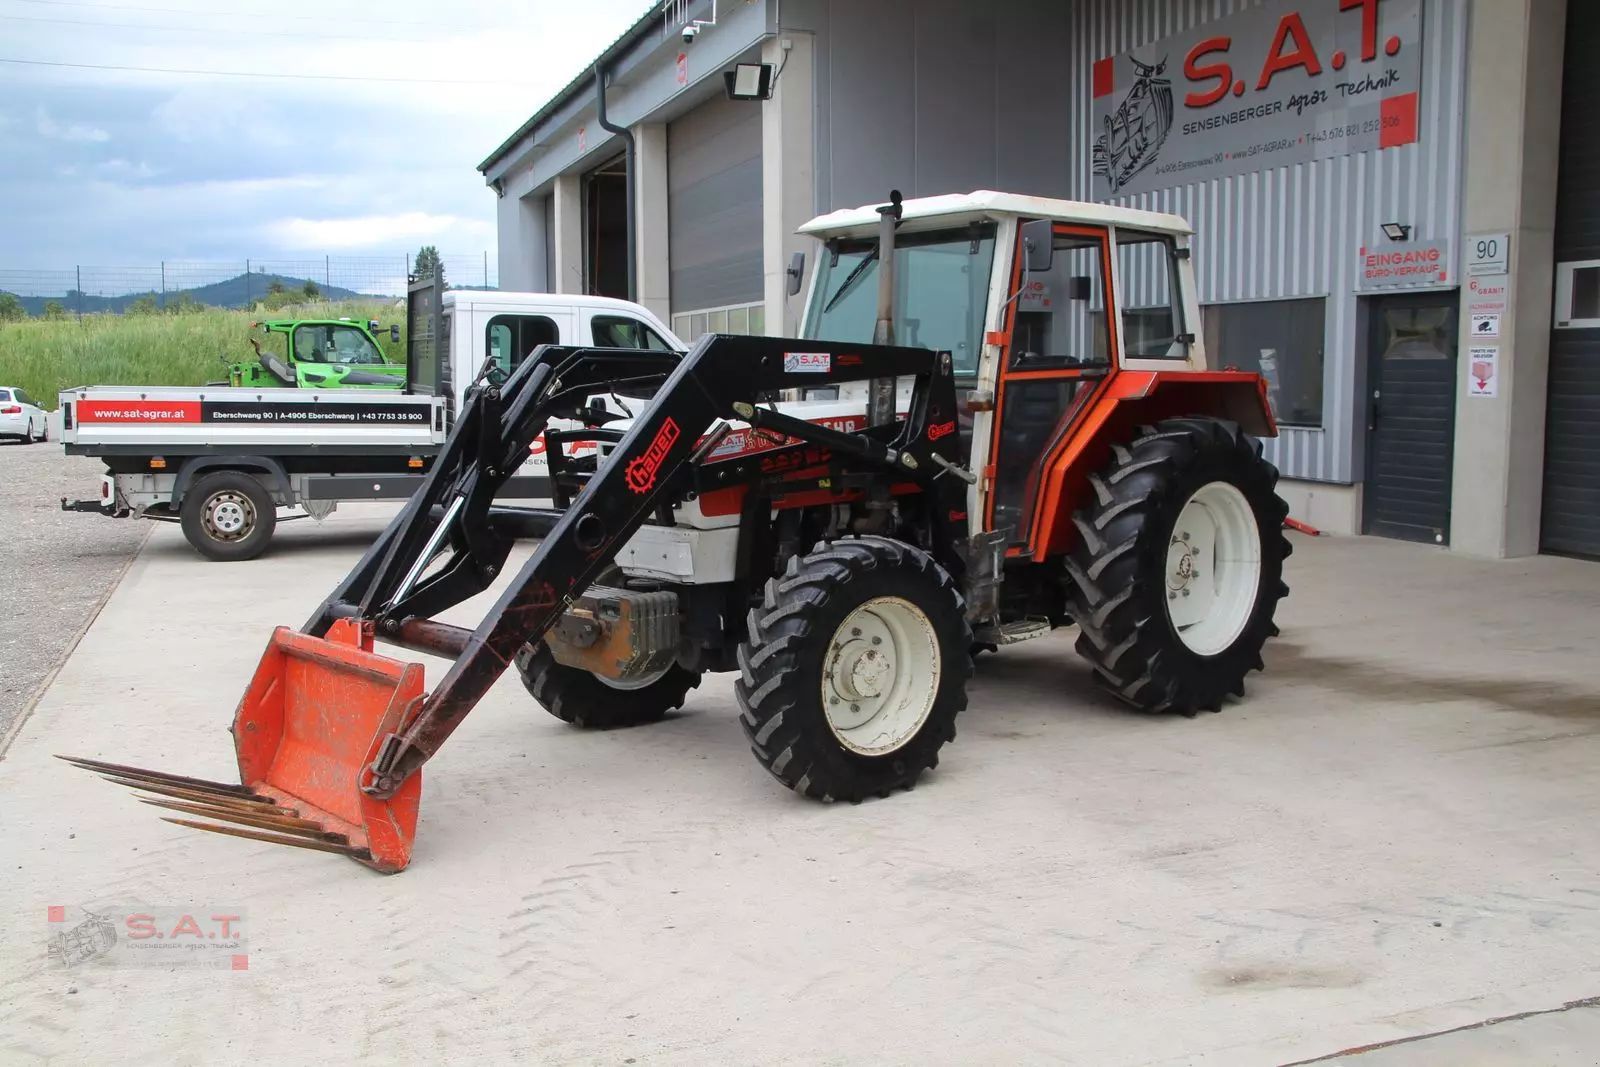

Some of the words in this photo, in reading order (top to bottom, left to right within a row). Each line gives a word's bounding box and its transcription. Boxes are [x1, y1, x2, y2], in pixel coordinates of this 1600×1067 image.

[1182, 101, 1283, 136] SENSENBERGER
[1286, 91, 1329, 116] Agrar
[1335, 68, 1401, 98] Technik
[1214, 152, 1224, 164] 90
[1345, 123, 1361, 137] 821
[1362, 119, 1379, 134] 252
[1366, 248, 1441, 267] EINGANG
[1477, 240, 1497, 259] 90
[95, 410, 185, 420] www.sat-agrar.at
[213, 411, 262, 421] Eberschwang
[308, 412, 355, 421] Eberschwang
